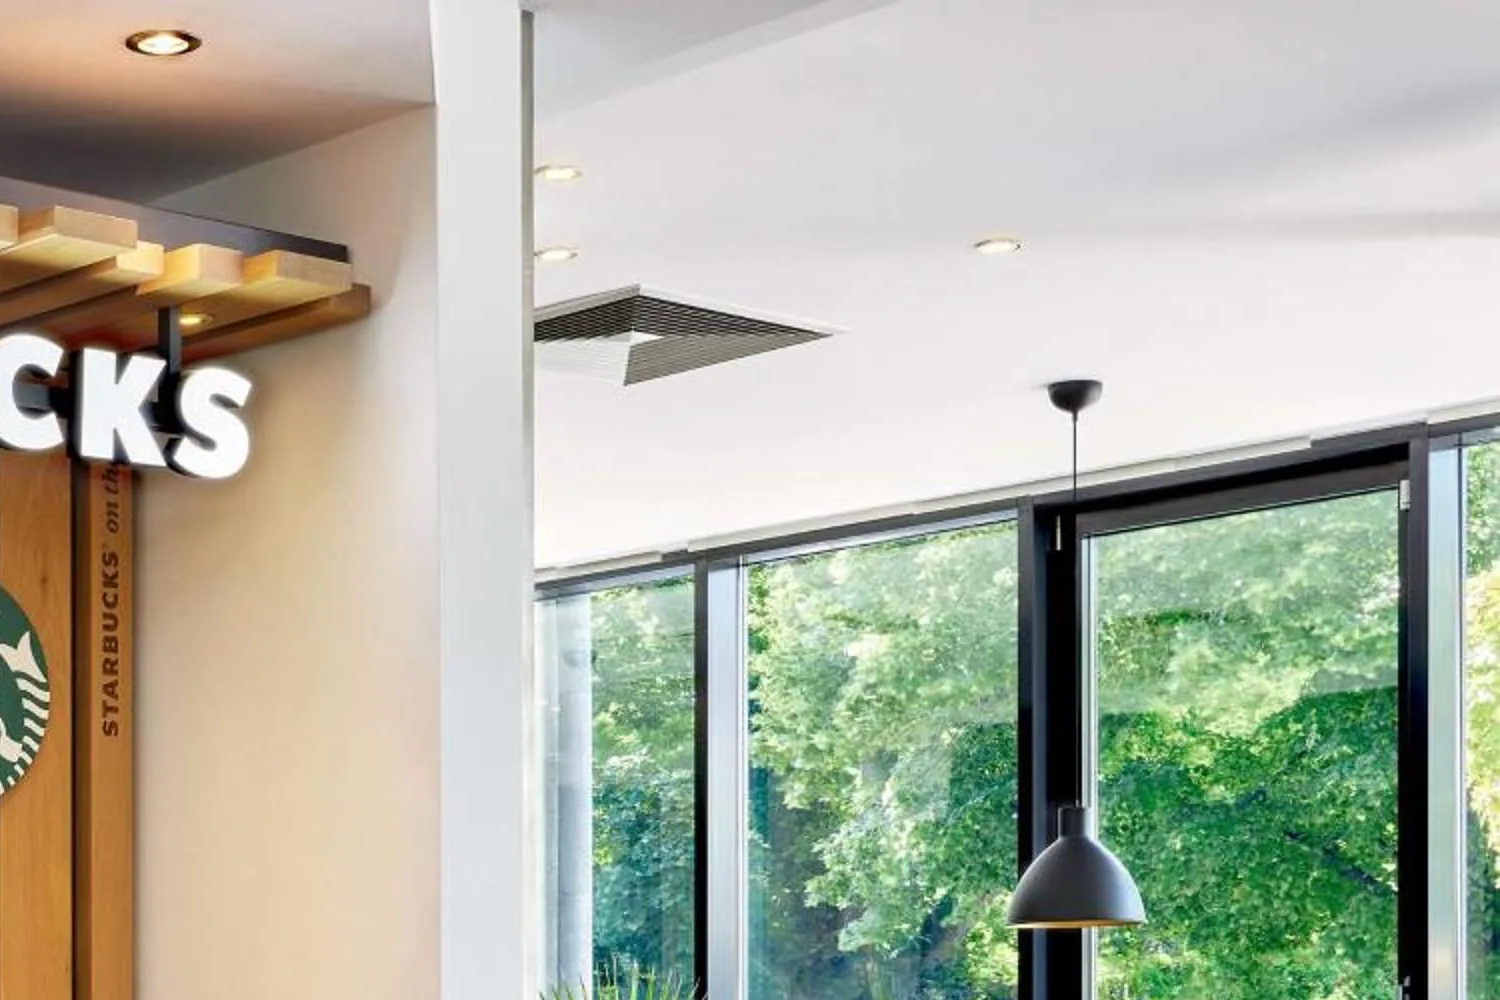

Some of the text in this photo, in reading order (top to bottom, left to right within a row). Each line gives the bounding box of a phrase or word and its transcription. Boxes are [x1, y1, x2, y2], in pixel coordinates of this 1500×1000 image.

[102, 461, 119, 737] STARBUCKS on th
